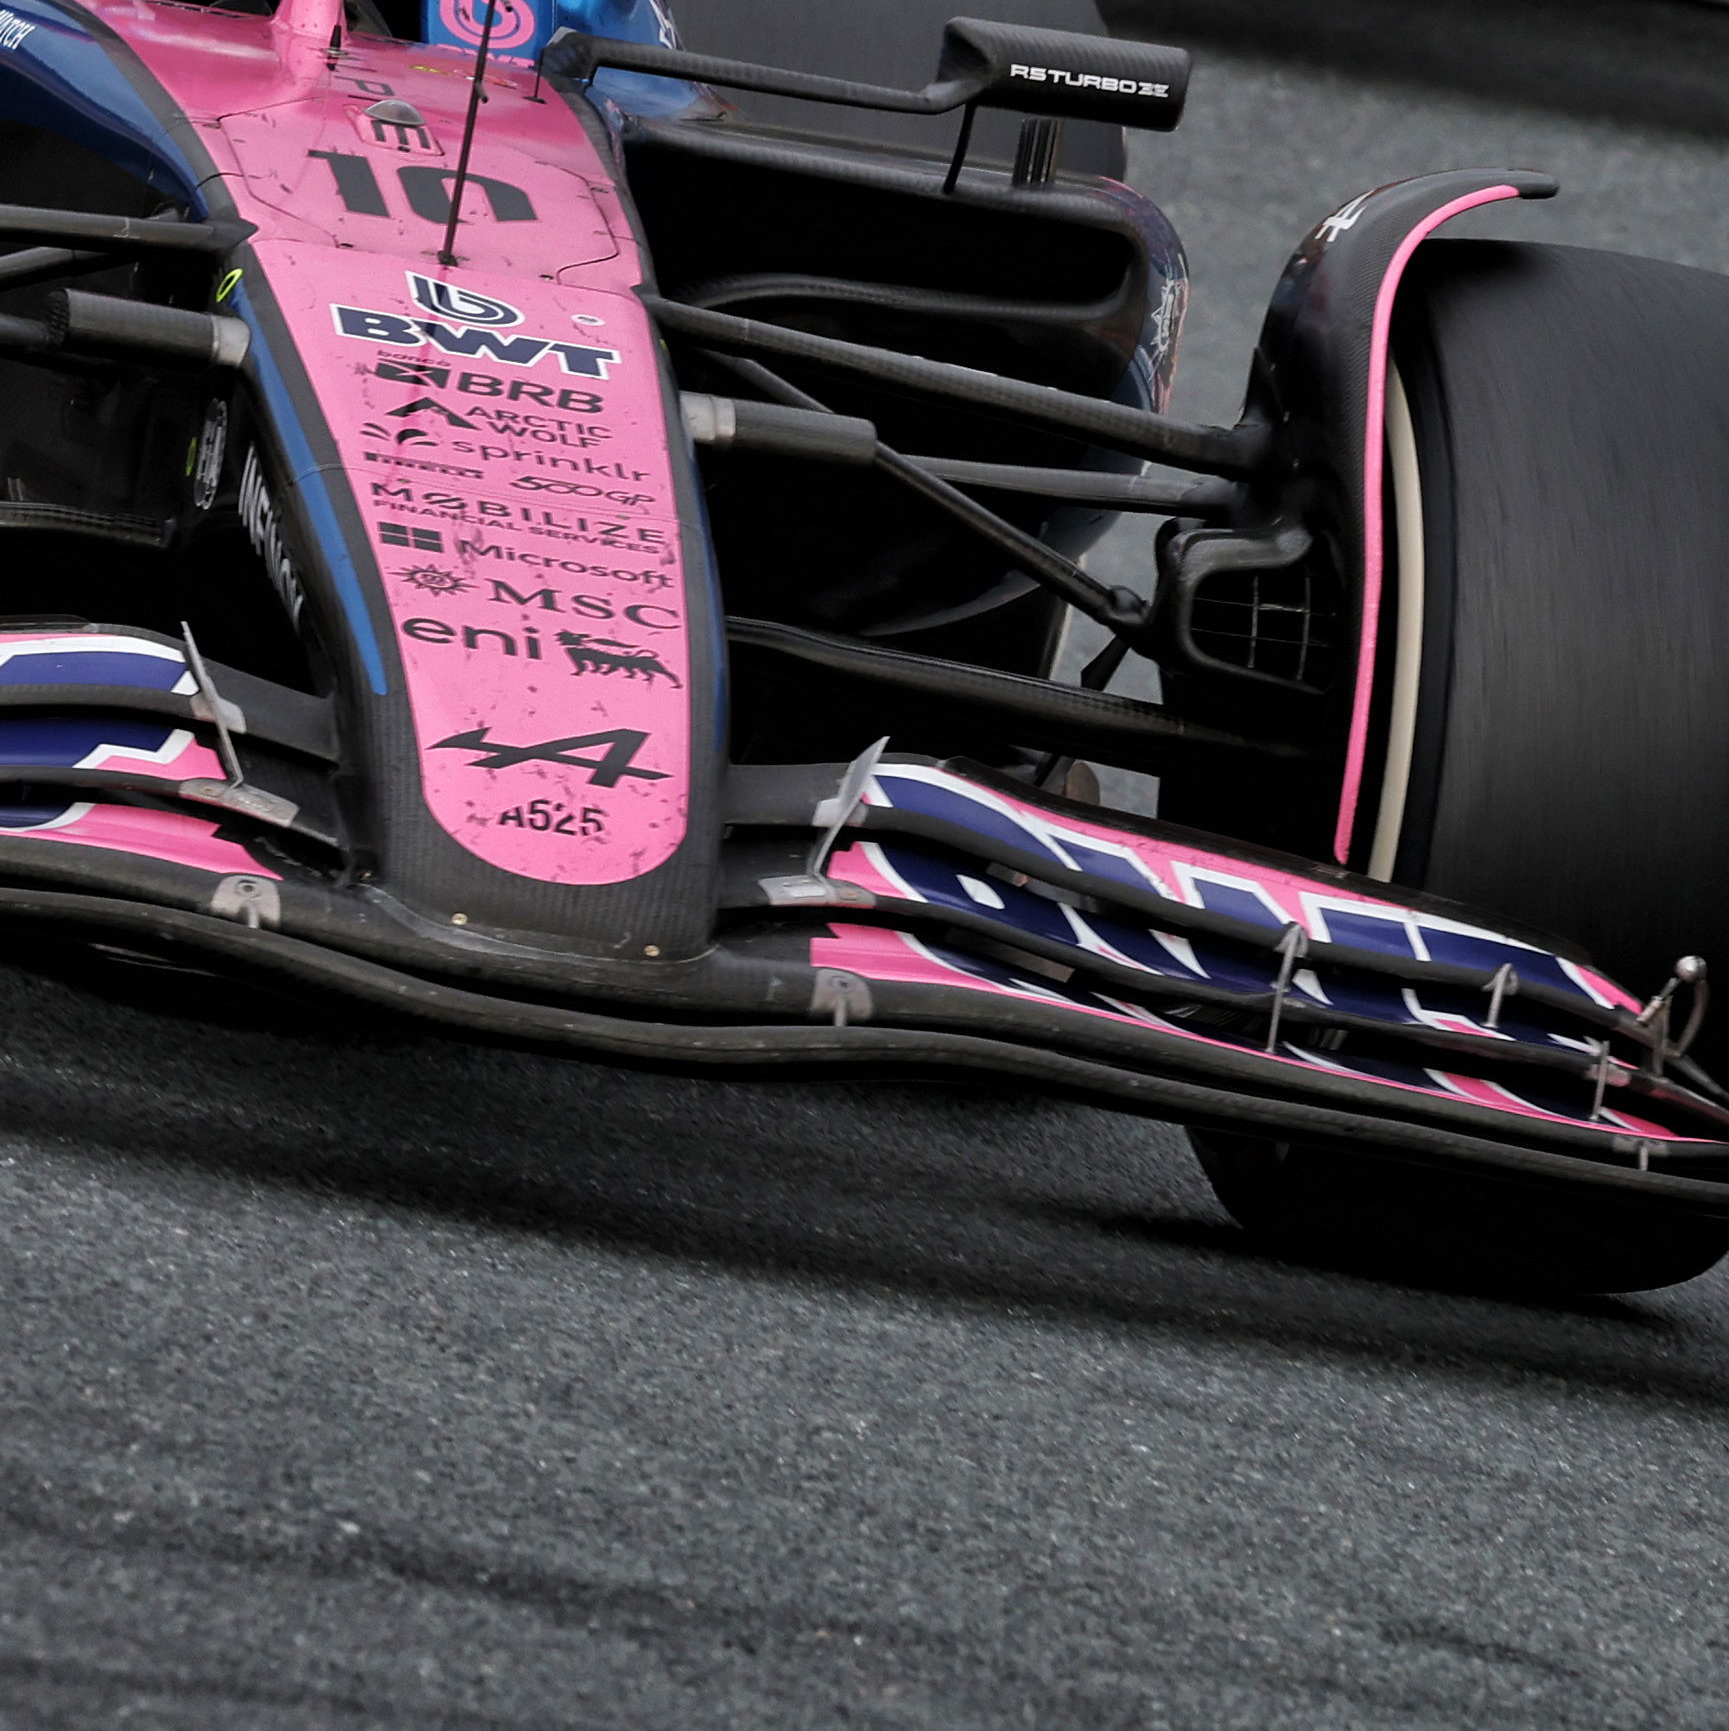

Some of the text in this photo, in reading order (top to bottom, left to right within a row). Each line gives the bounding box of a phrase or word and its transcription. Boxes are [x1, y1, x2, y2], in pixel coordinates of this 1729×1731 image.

[307, 149, 538, 225] 10
[329, 303, 622, 380] BWT
[376, 349, 452, 368] banco
[456, 371, 604, 414] BRB
[464, 406, 613, 439] ARCTIC
[486, 421, 602, 449] WOLF
[452, 440, 651, 482] sprinklr
[373, 499, 662, 554] FINANCIAL SERVICES
[459, 539, 674, 588] Microsoft
[485, 577, 681, 630] MSC
[402, 617, 543, 660] eni
[497, 799, 608, 837] A525
